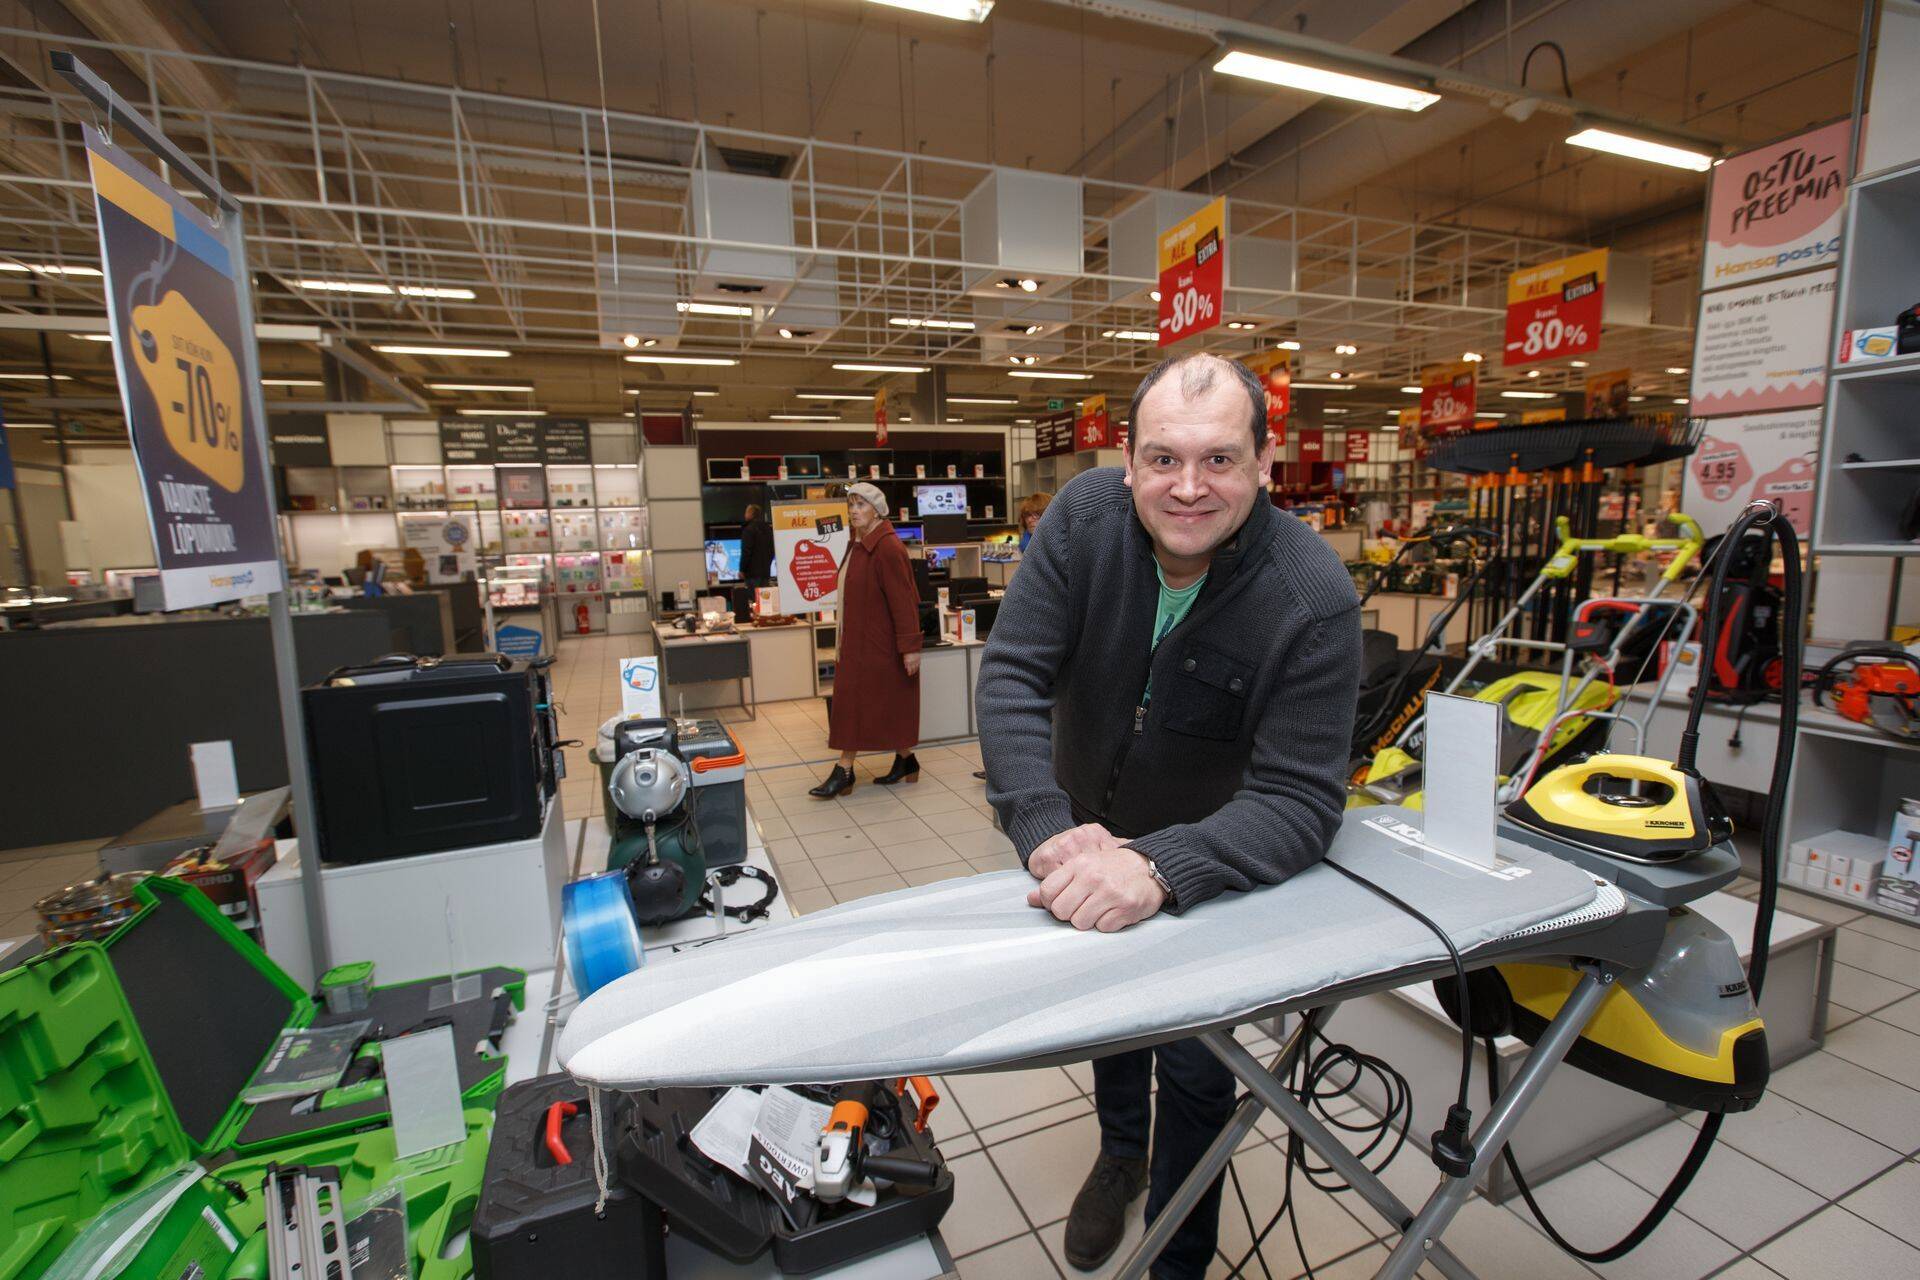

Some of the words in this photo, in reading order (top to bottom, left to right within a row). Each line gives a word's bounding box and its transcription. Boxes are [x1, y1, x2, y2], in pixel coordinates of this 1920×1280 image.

[1743, 148, 1837, 201] OSTU-
[1730, 169, 1841, 235] PREEMIA
[1159, 287, 1214, 333] -80%
[1506, 318, 1588, 356] -80%
[172, 357, 239, 452] -70%
[1422, 396, 1468, 419] -80%
[1701, 462, 1737, 479] 4.95
[759, 1154, 796, 1204] AEG
